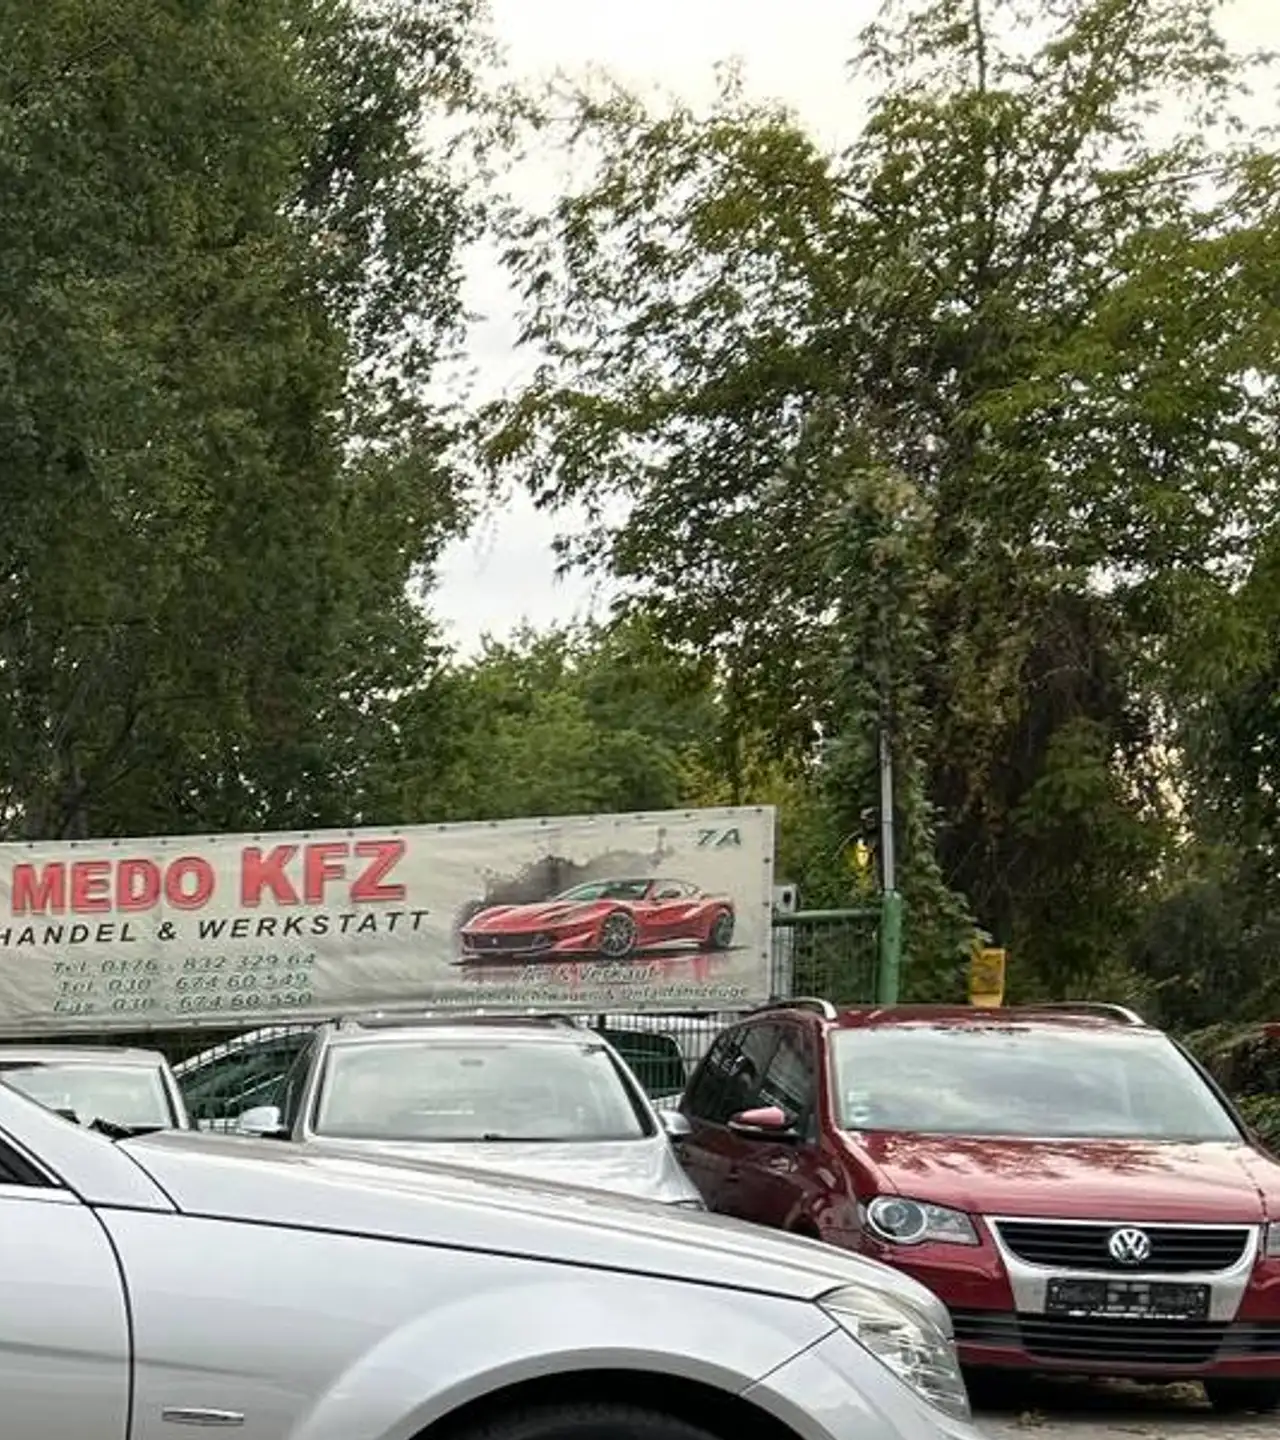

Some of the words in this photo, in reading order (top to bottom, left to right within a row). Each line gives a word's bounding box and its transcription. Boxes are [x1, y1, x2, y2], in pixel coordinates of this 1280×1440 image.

[697, 827, 741, 847] 7A
[11, 855, 216, 917] MEDO
[240, 839, 407, 909] KFZ
[158, 920, 178, 941] &
[199, 910, 430, 939] WERKSTATT
